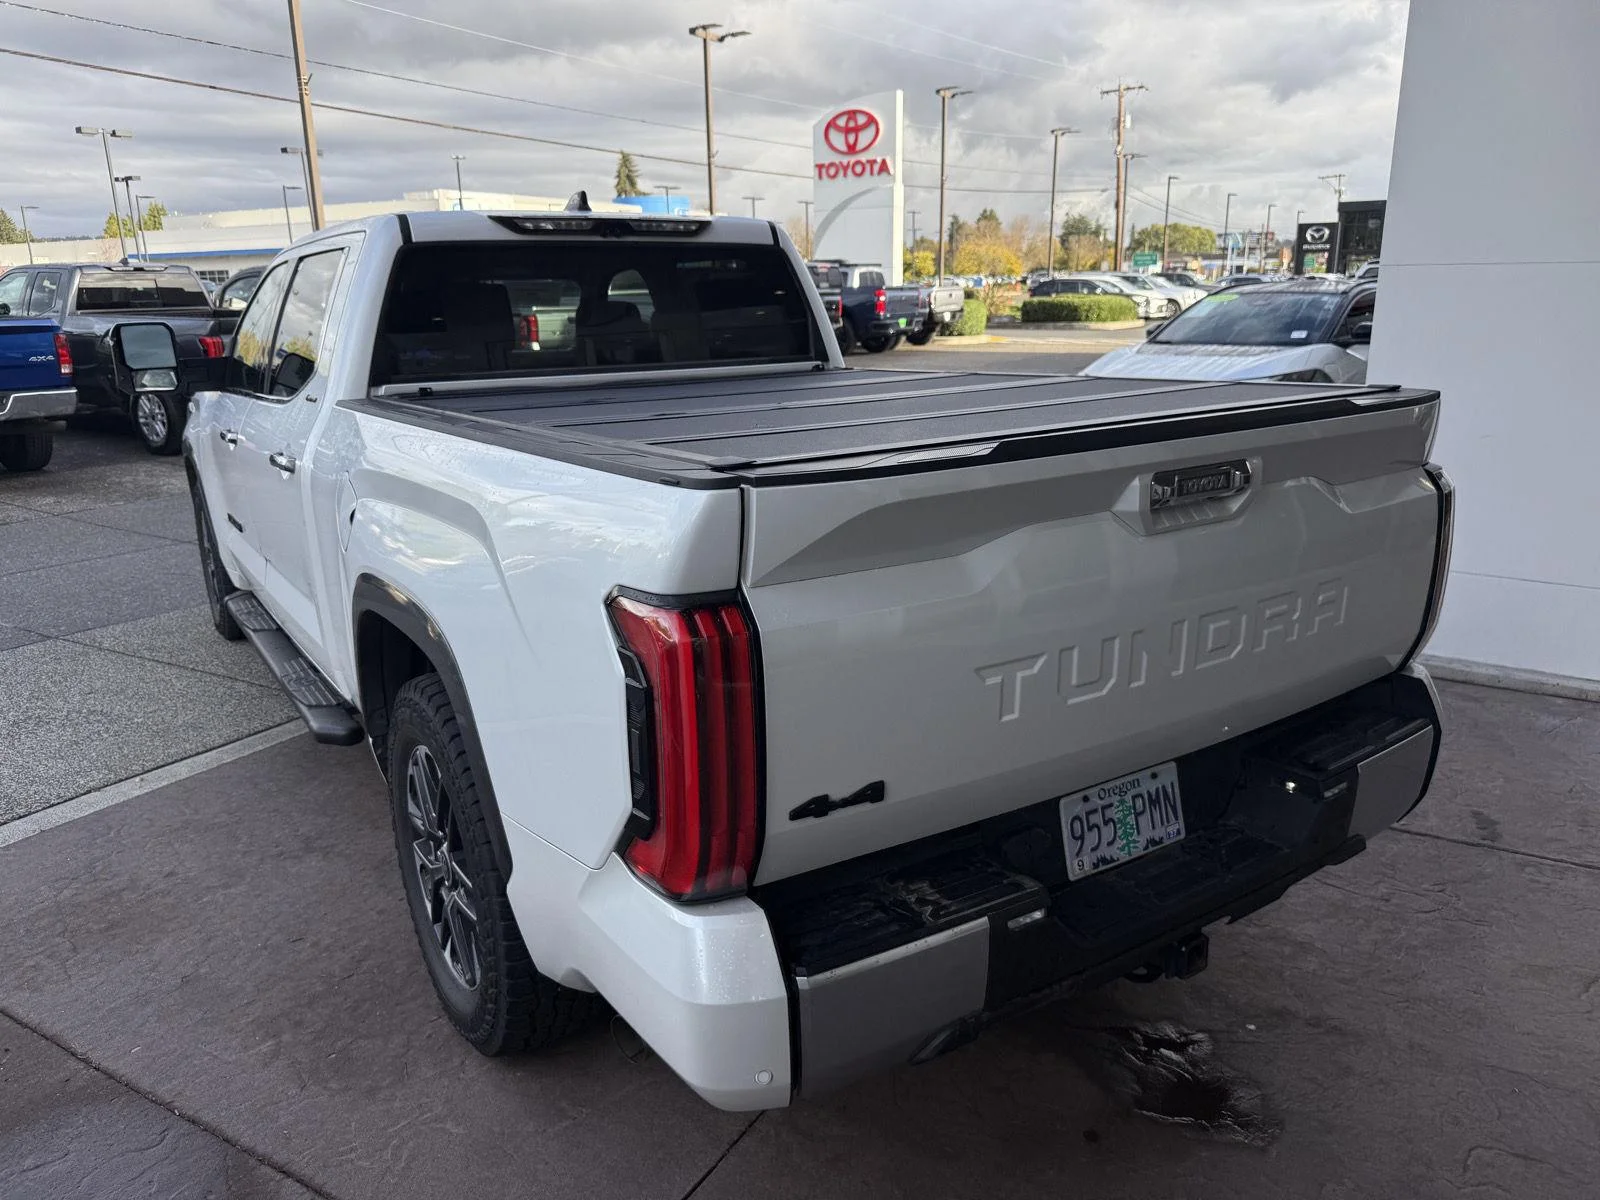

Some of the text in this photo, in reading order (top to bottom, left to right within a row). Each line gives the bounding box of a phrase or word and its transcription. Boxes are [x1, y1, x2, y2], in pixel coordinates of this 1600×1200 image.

[815, 158, 892, 180] TOYOTA
[1182, 474, 1226, 494] TOYOTA
[974, 577, 1348, 722] TUNDRA
[1098, 778, 1141, 800] Oregon
[1070, 781, 1179, 857] 955 PMN
